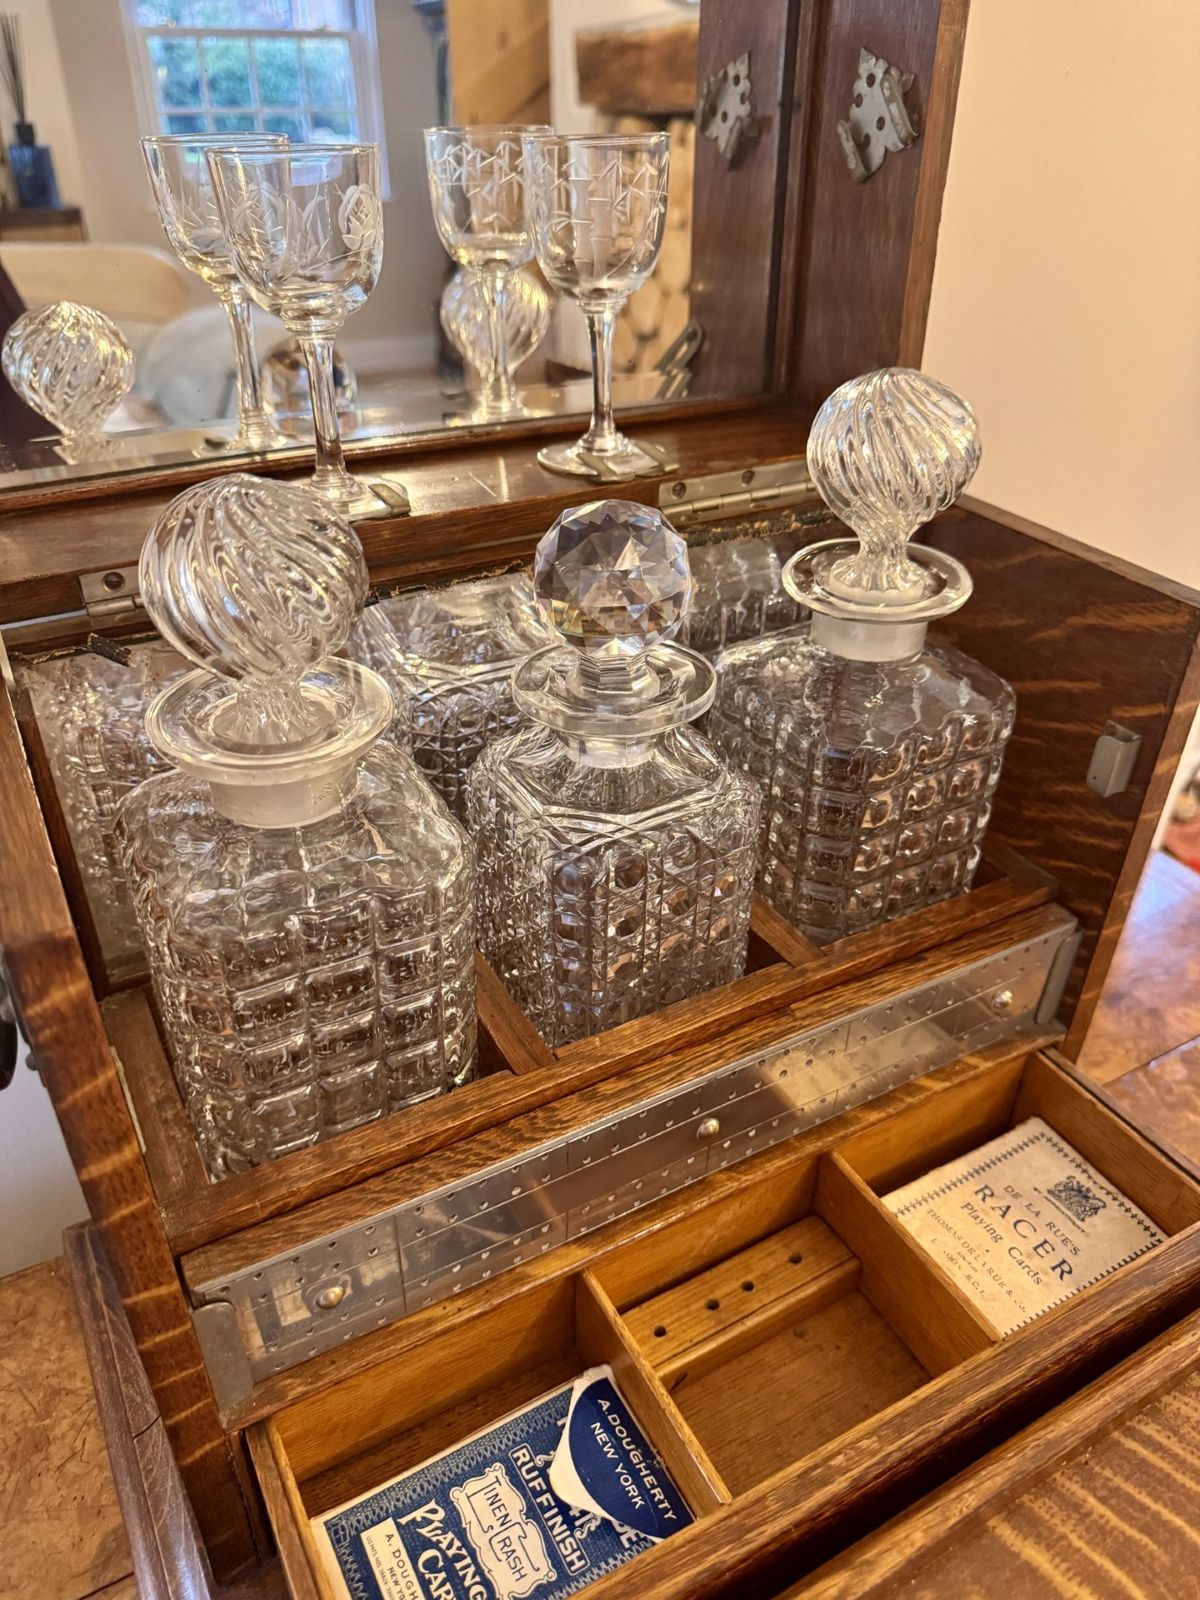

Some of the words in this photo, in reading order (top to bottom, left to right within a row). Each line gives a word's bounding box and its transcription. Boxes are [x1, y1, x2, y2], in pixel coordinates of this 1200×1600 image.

[961, 1202, 1003, 1243] Playing
[1008, 1246, 1042, 1285] Cards
[974, 1184, 1073, 1281] RACER
[1004, 1185, 1022, 1199] DE
[1025, 1203, 1040, 1217] LA
[1045, 1221, 1080, 1256] RUE'S
[986, 1267, 1006, 1288] RUE
[591, 1422, 619, 1459] NEW
[615, 1462, 646, 1510] YORK
[385, 1534, 394, 1546] A.
[397, 1498, 487, 1600] PLAYING
[418, 1549, 456, 1600] CAR
[388, 1567, 400, 1586] NEW
